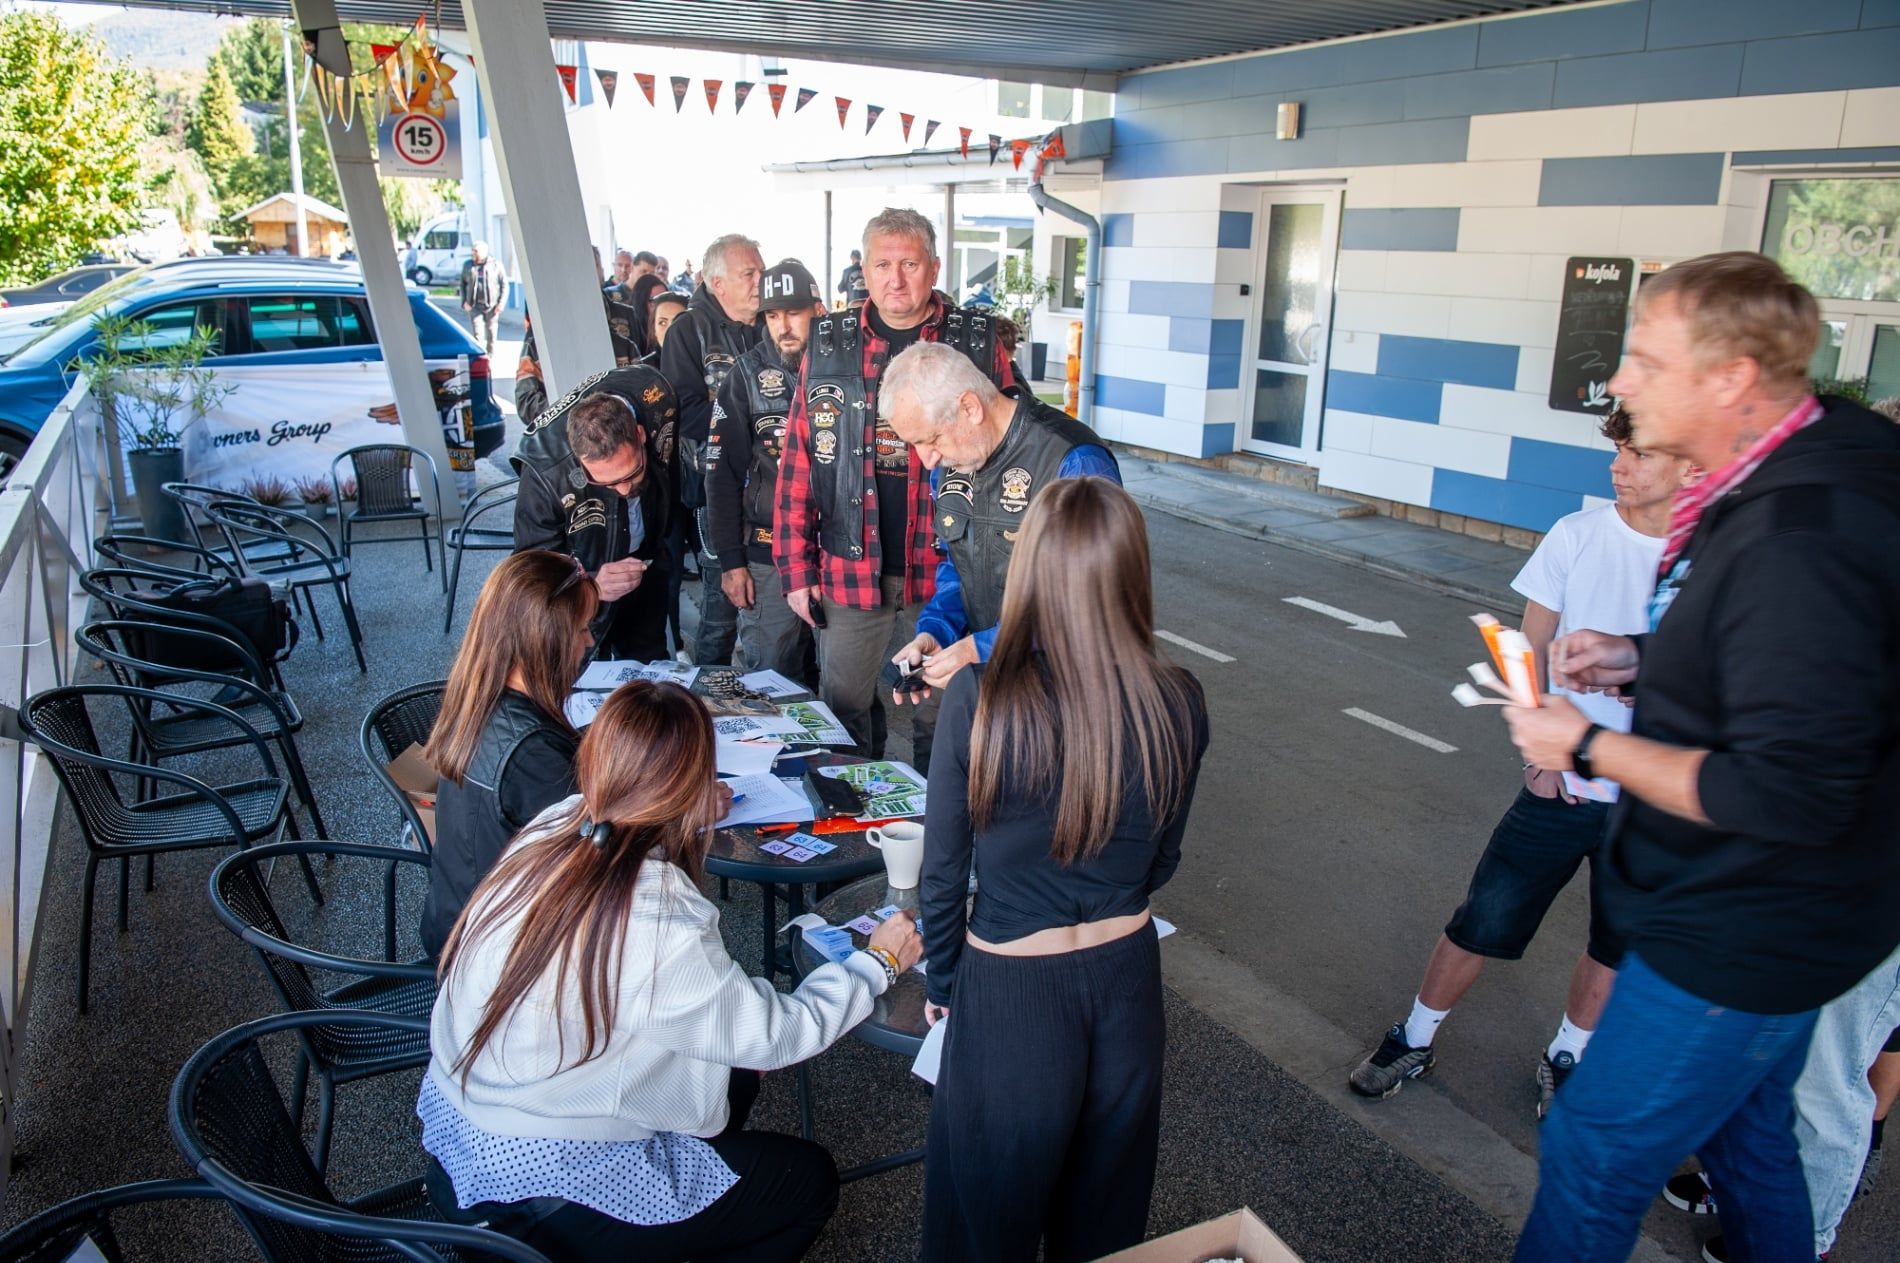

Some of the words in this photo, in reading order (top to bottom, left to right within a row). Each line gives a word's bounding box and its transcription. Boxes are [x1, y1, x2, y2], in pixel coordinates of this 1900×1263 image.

[404, 126, 433, 147] 15
[1585, 263, 1621, 284] kofola
[764, 273, 794, 299] H-D
[266, 420, 332, 446] Group
[857, 921, 875, 932] 65
